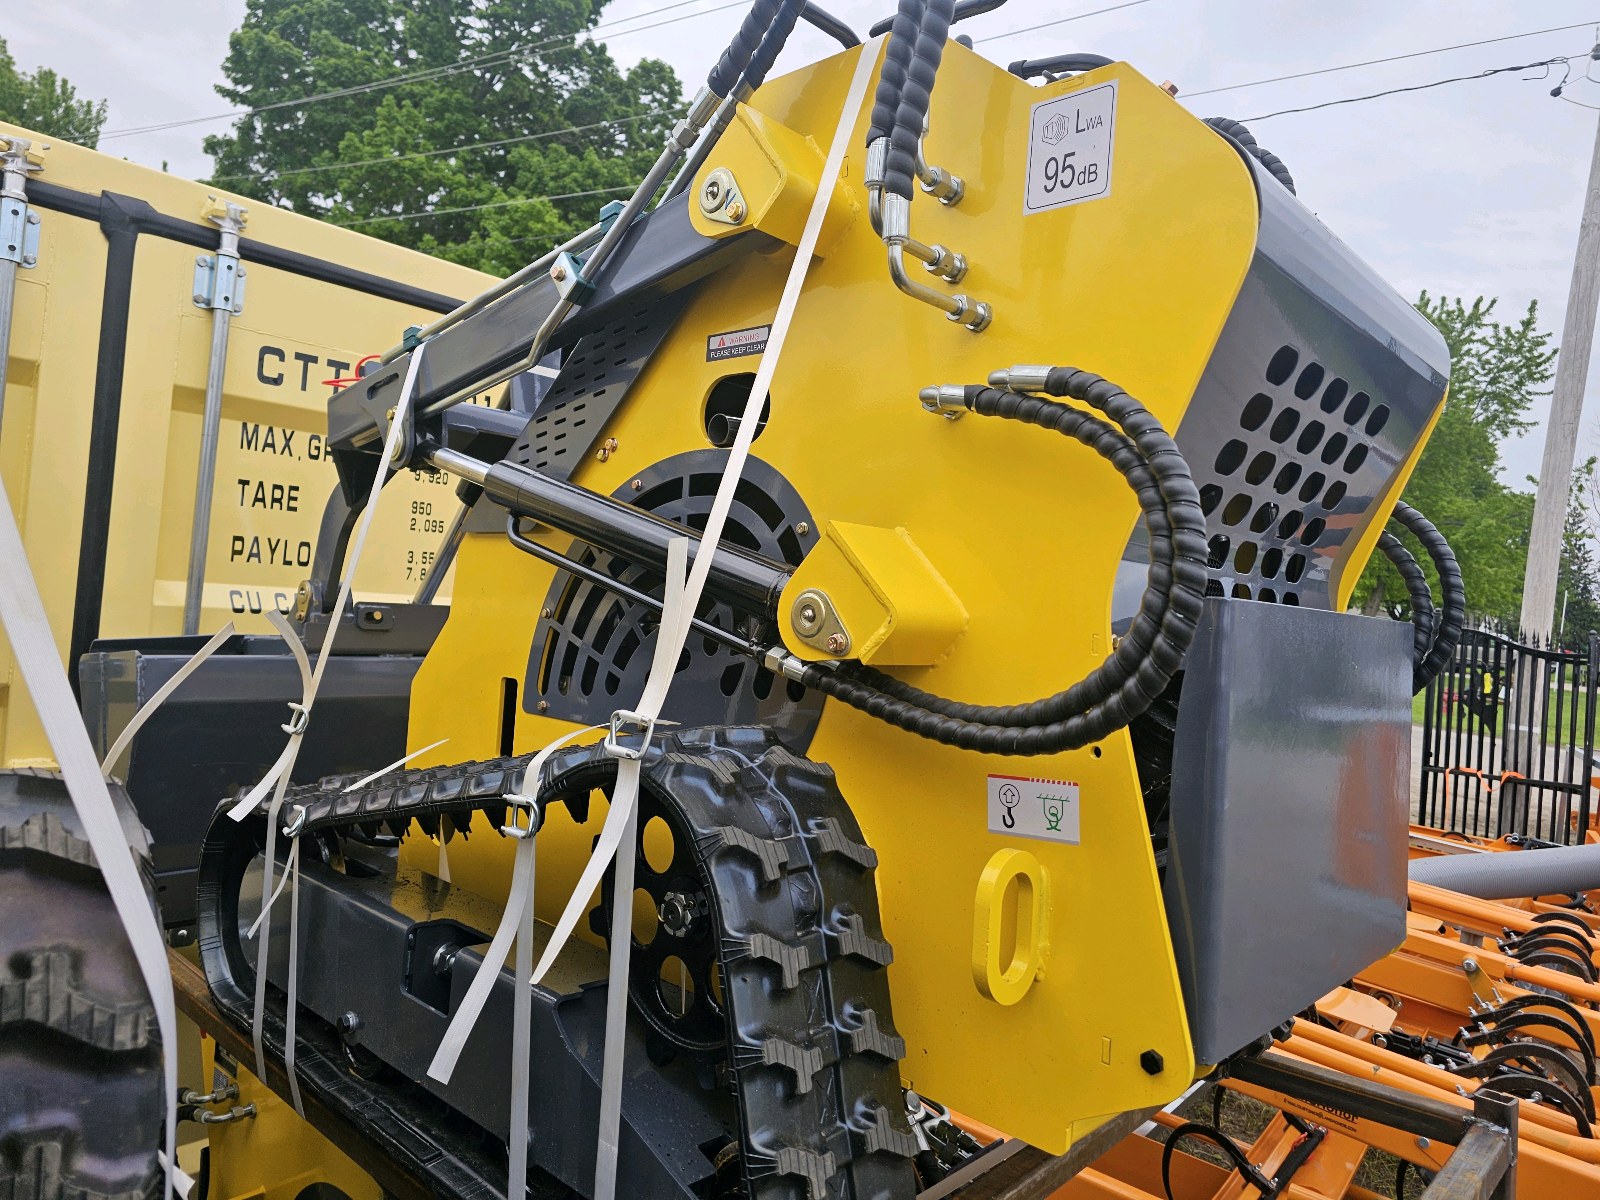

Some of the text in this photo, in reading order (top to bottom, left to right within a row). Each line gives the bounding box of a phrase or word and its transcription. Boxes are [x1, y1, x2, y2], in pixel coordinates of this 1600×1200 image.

[710, 343, 765, 358] PLEASE KEEP CLEAR
[729, 333, 760, 344] WARNING
[257, 345, 366, 396] CTT
[237, 478, 300, 512] TARE
[411, 500, 432, 516] 950
[230, 535, 311, 567] PAYLO
[229, 589, 262, 614] CU
